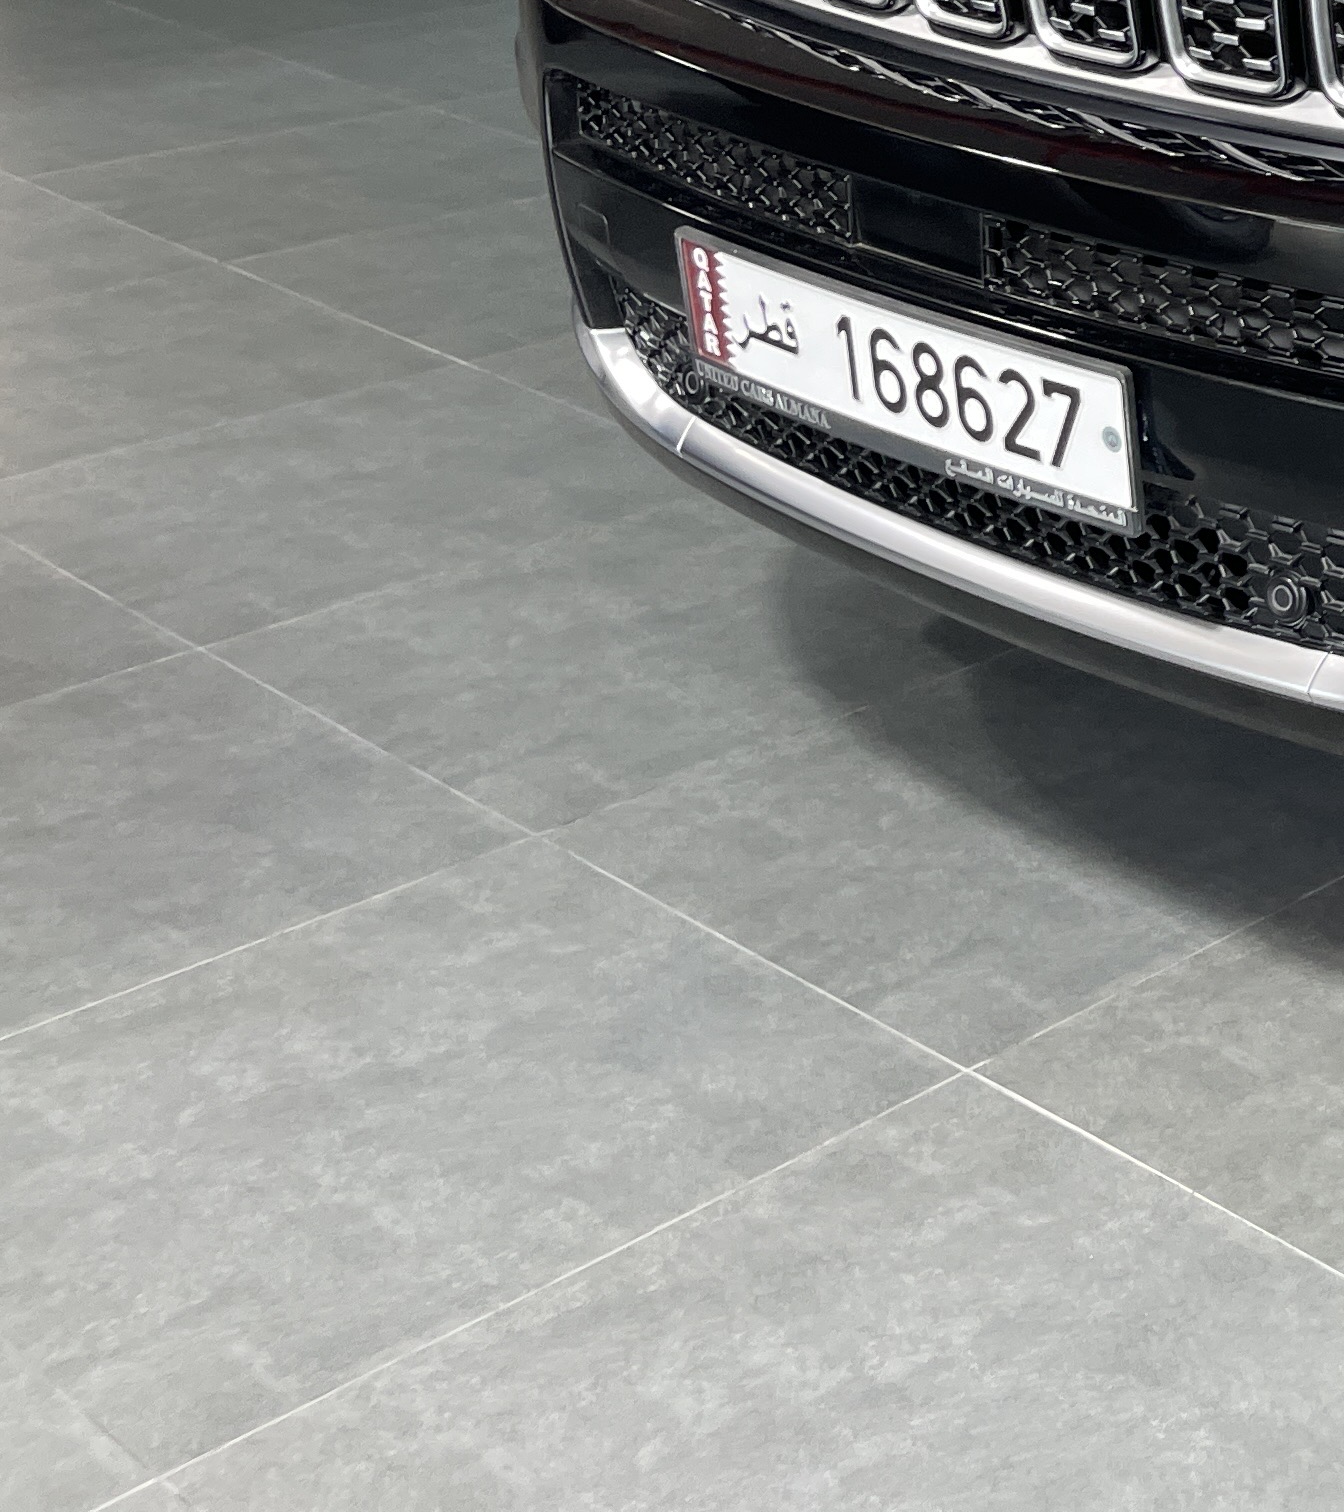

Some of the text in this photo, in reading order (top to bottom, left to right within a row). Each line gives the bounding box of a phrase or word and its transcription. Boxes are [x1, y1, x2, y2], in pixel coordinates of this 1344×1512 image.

[692, 247, 722, 357] QATAR
[731, 293, 800, 356] قطر
[740, 380, 775, 406] CARS
[835, 314, 1082, 468] 168627
